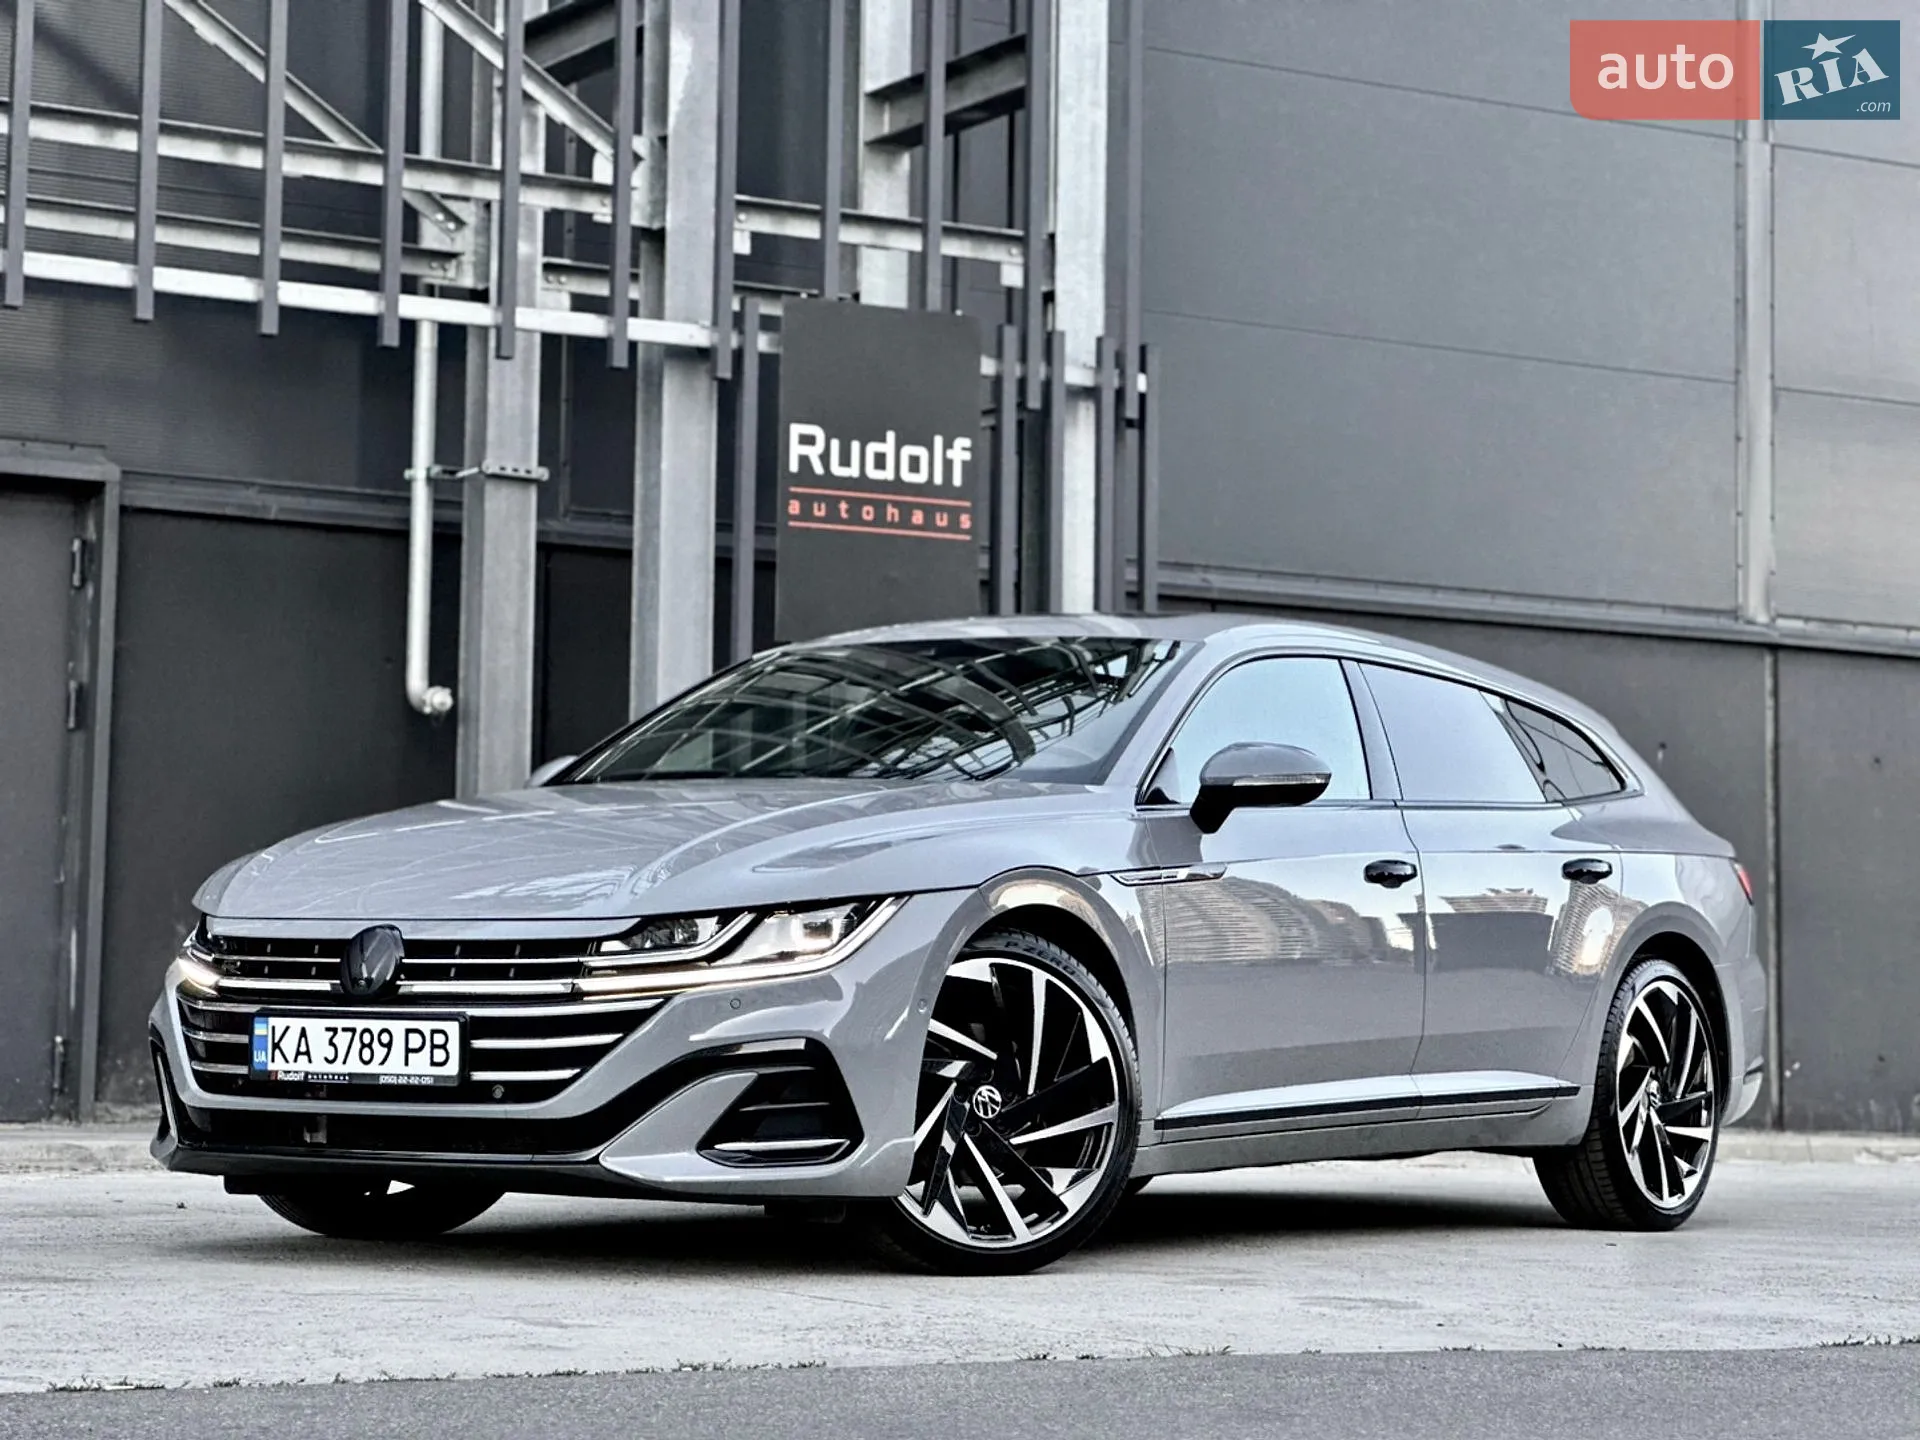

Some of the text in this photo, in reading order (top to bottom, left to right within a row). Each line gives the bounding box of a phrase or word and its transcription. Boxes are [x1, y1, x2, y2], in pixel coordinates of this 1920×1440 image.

[788, 422, 972, 488] Rudolf
[787, 499, 972, 530] autohaus
[271, 1025, 450, 1067] KA 3789 PB
